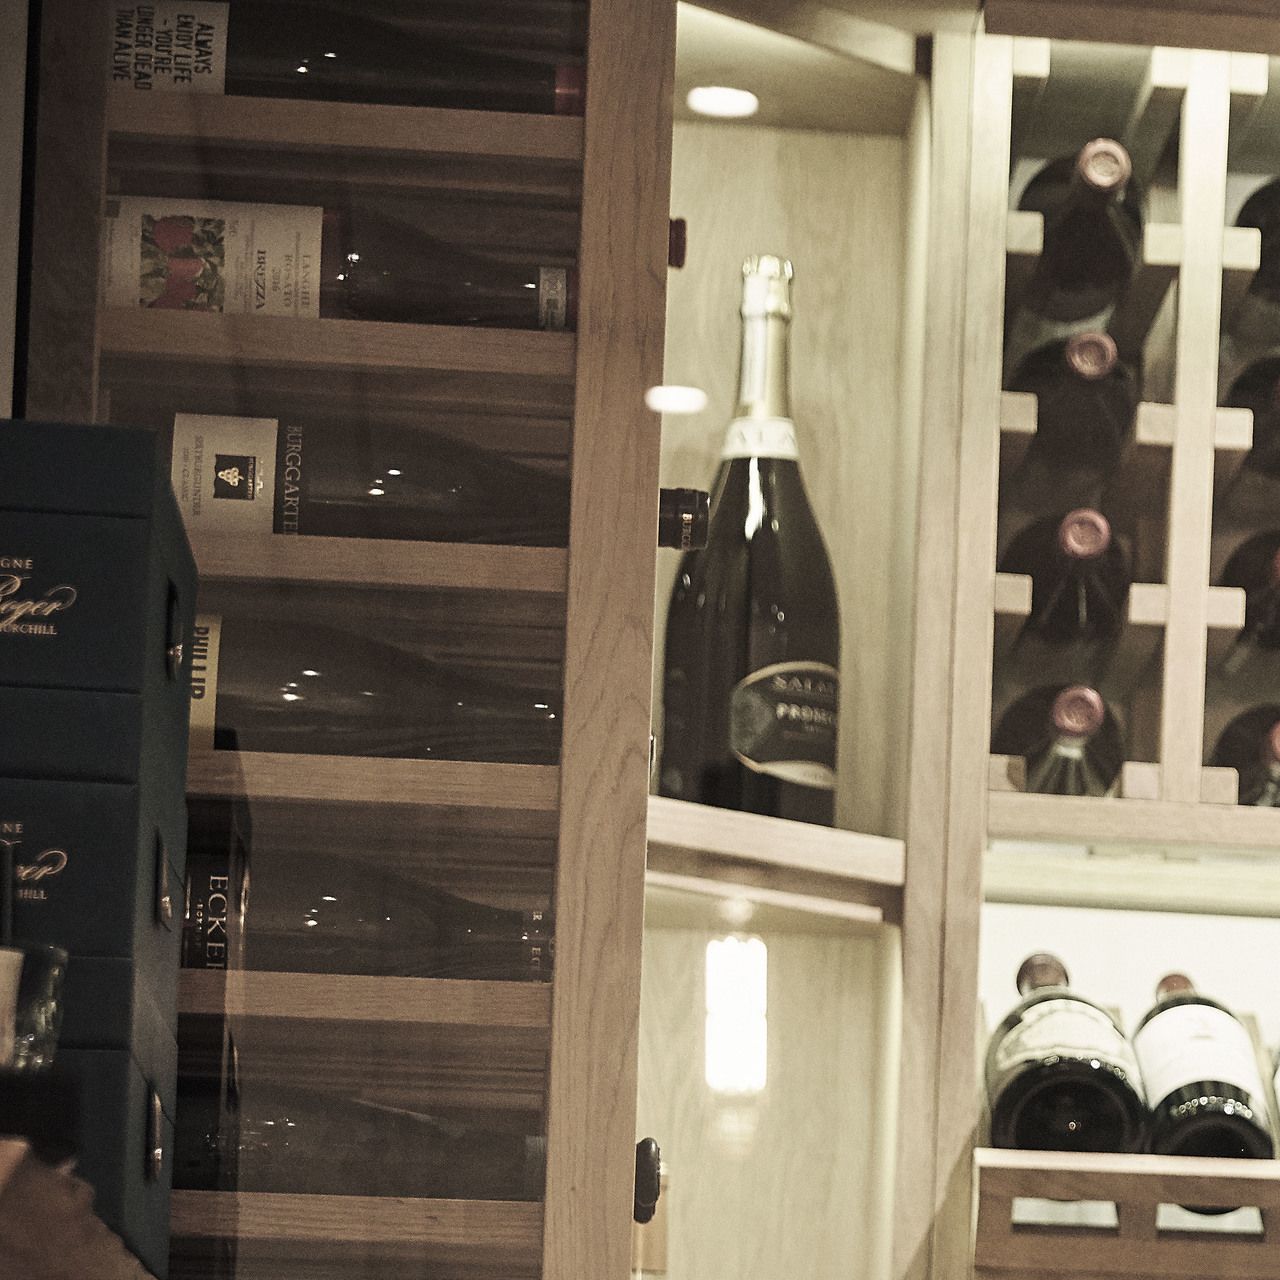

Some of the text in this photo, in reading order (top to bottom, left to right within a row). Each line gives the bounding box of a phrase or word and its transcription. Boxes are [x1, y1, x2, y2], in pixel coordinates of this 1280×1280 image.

[113, 9, 135, 80] THAN ALIVE
[134, 6, 154, 90] LONGER DEAD
[154, 30, 173, 74] YOU'RE
[174, 14, 195, 83] ENJOY LIFE
[193, 22, 215, 74] ALWAYS
[255, 249, 267, 310] BREZZA
